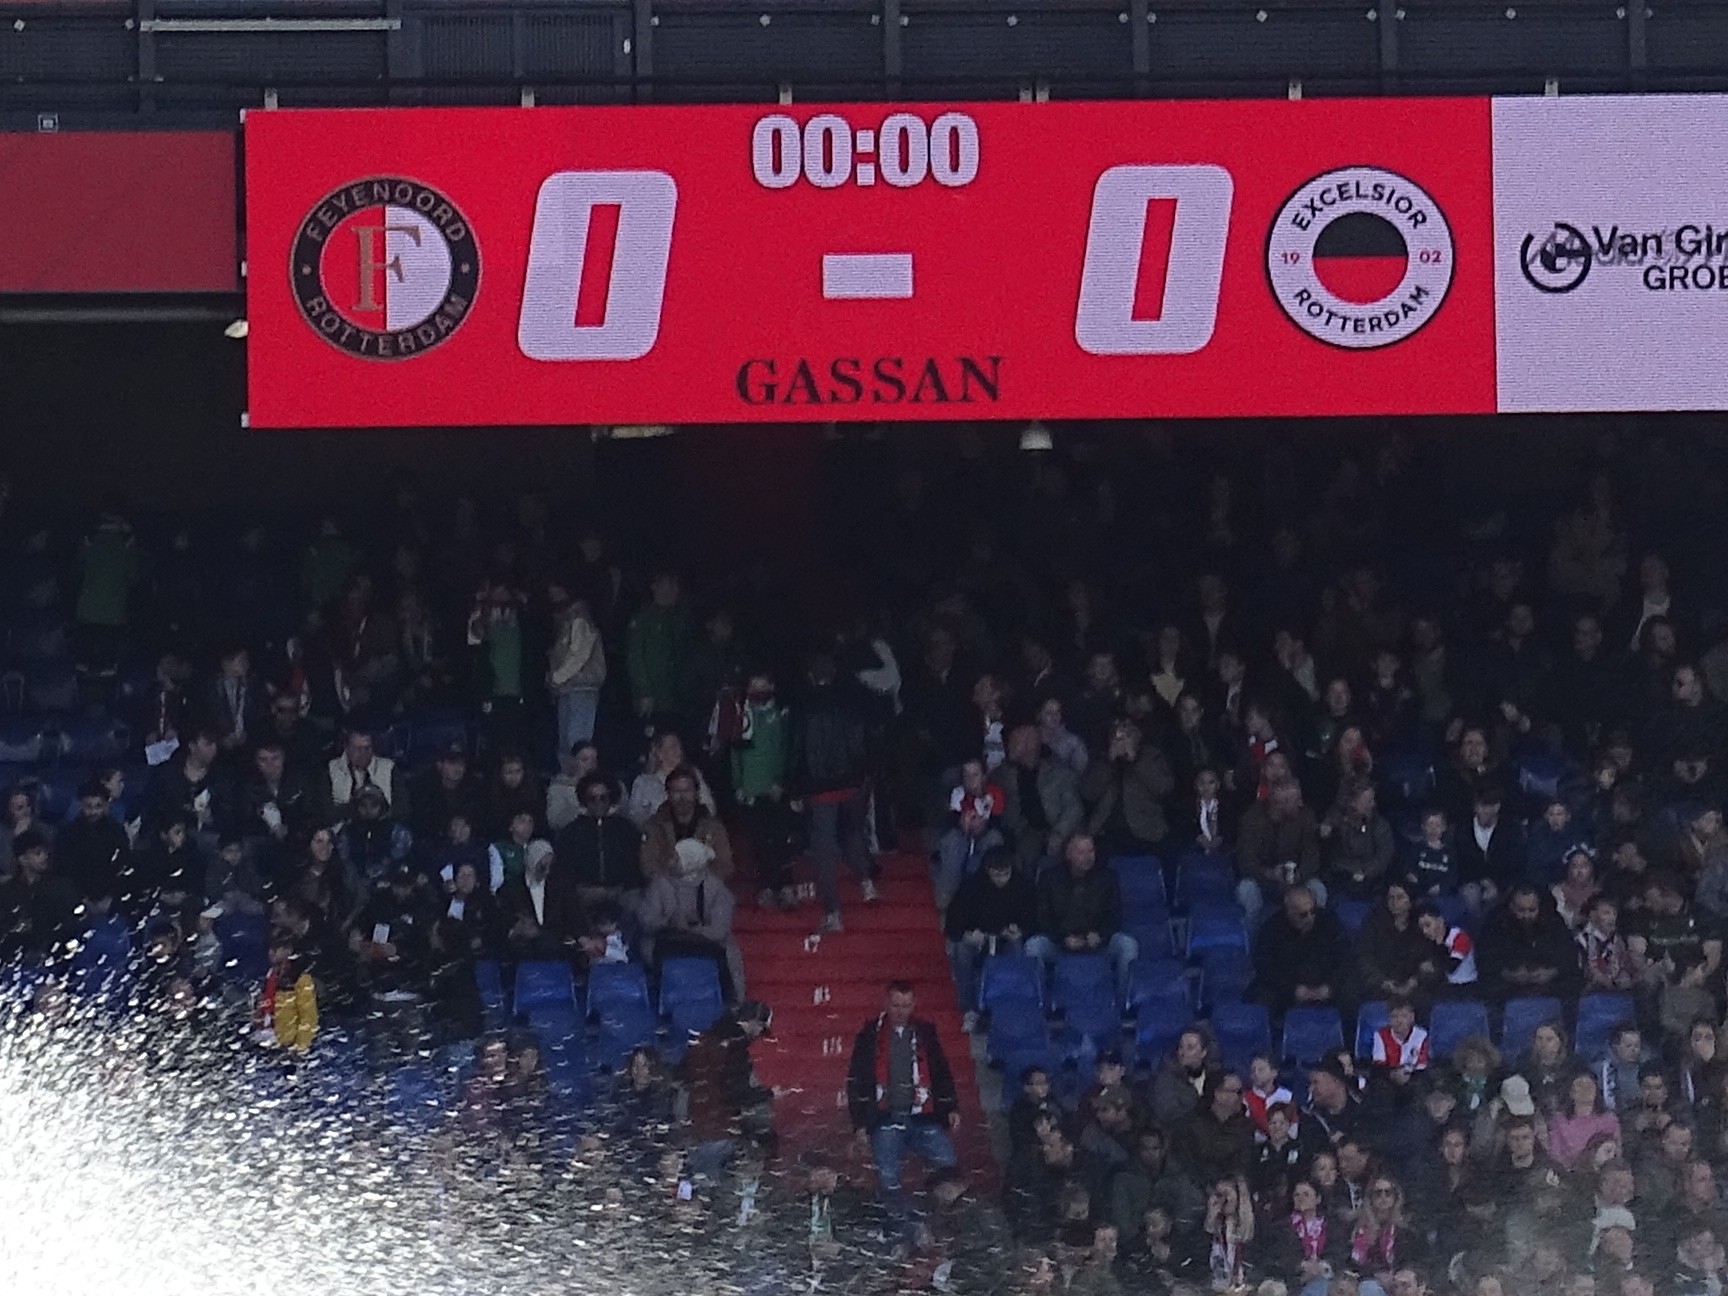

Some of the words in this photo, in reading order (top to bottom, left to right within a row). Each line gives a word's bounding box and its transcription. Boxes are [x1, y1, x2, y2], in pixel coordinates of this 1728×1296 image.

[752, 112, 980, 188] 00:00
[306, 181, 467, 242] FEYENOORD
[1292, 179, 1428, 231] EXCELSIOR
[517, 170, 679, 362] 0
[1074, 164, 1236, 356] 0
[1280, 251, 1301, 266] 19
[1418, 249, 1443, 265] 02
[1592, 225, 1663, 256] Van
[350, 224, 423, 312] F
[305, 292, 469, 357] ROTTERDAM
[1293, 284, 1431, 334] ROTTERDAM
[734, 356, 1005, 406] GASSAN
